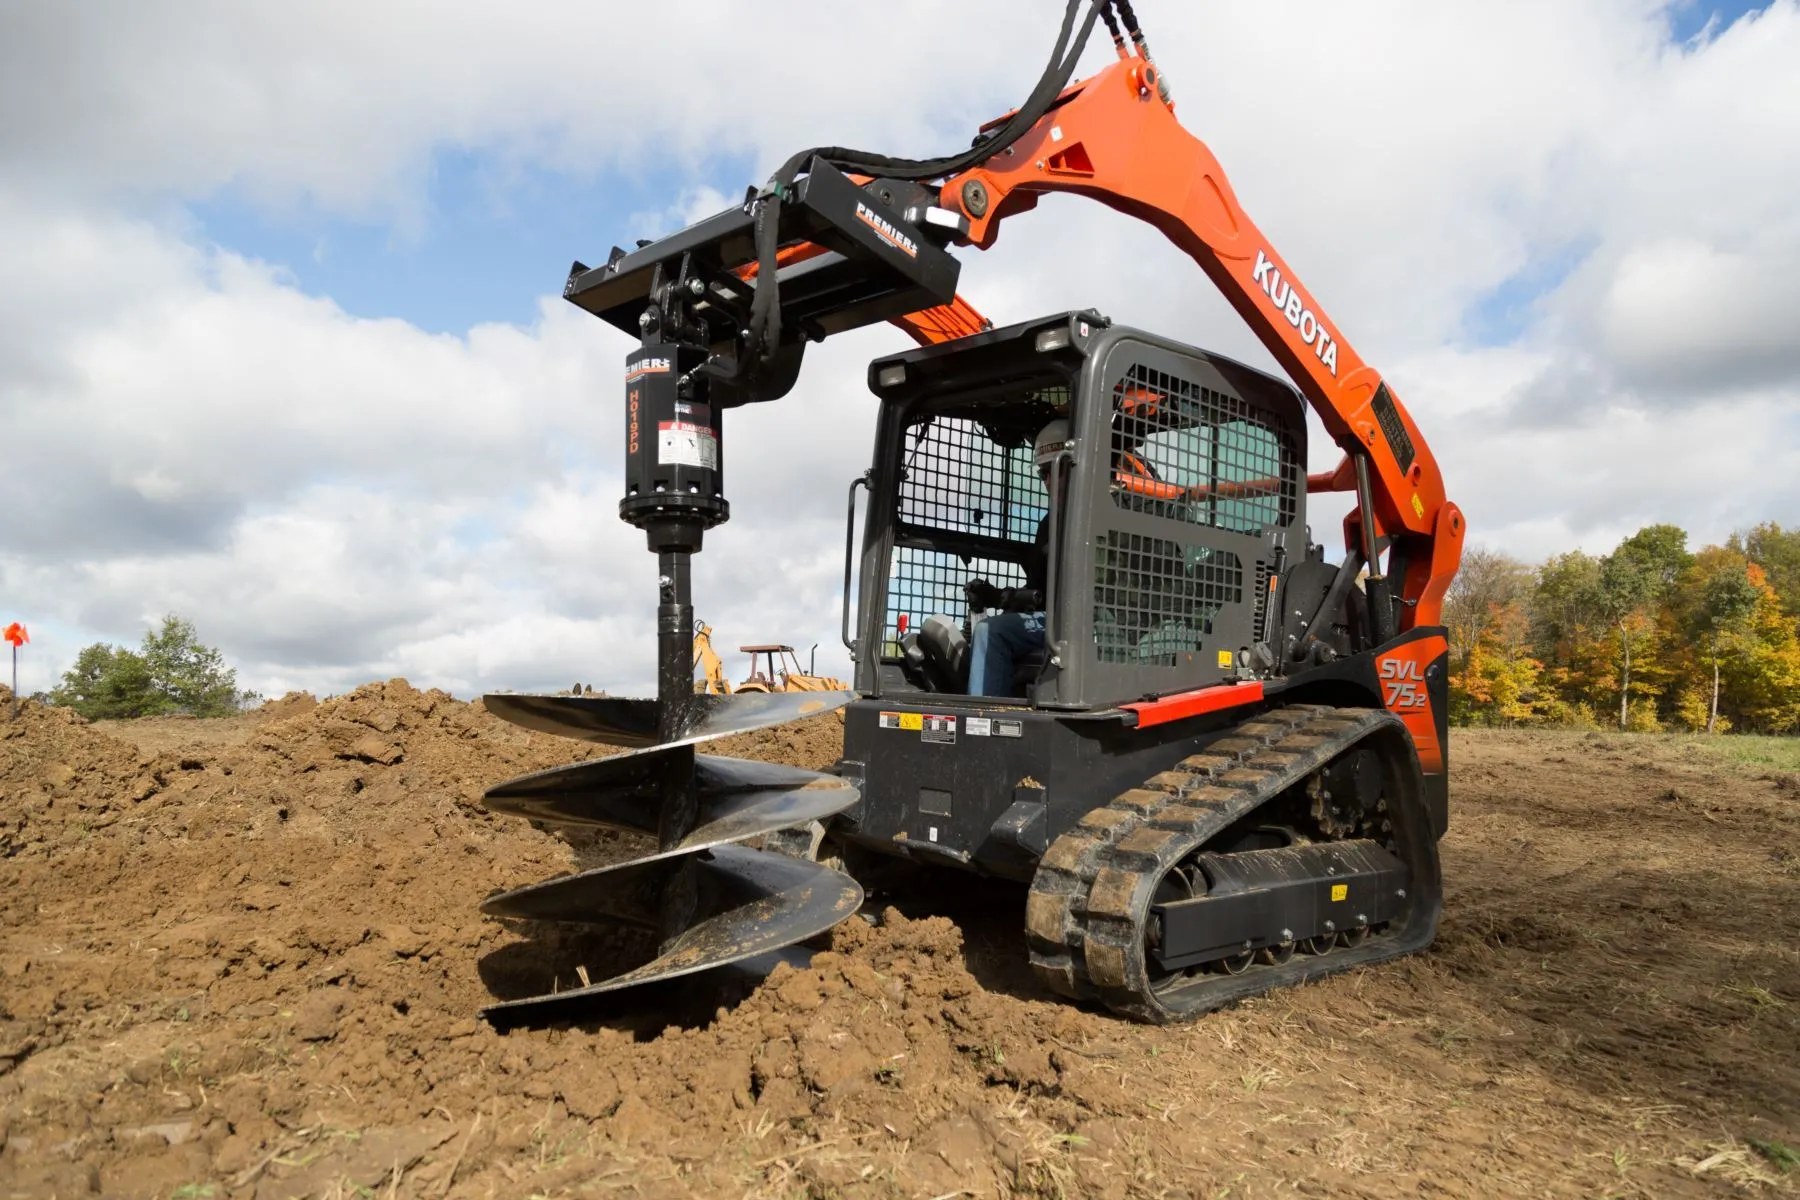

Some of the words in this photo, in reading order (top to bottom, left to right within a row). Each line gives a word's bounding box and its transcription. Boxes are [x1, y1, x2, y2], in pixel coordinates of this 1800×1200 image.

[857, 201, 913, 250] PREMIER
[1253, 248, 1337, 377] KUBOTA
[626, 358, 663, 373] EMIER
[681, 423, 713, 434] DANGER
[1379, 658, 1424, 681] SVL
